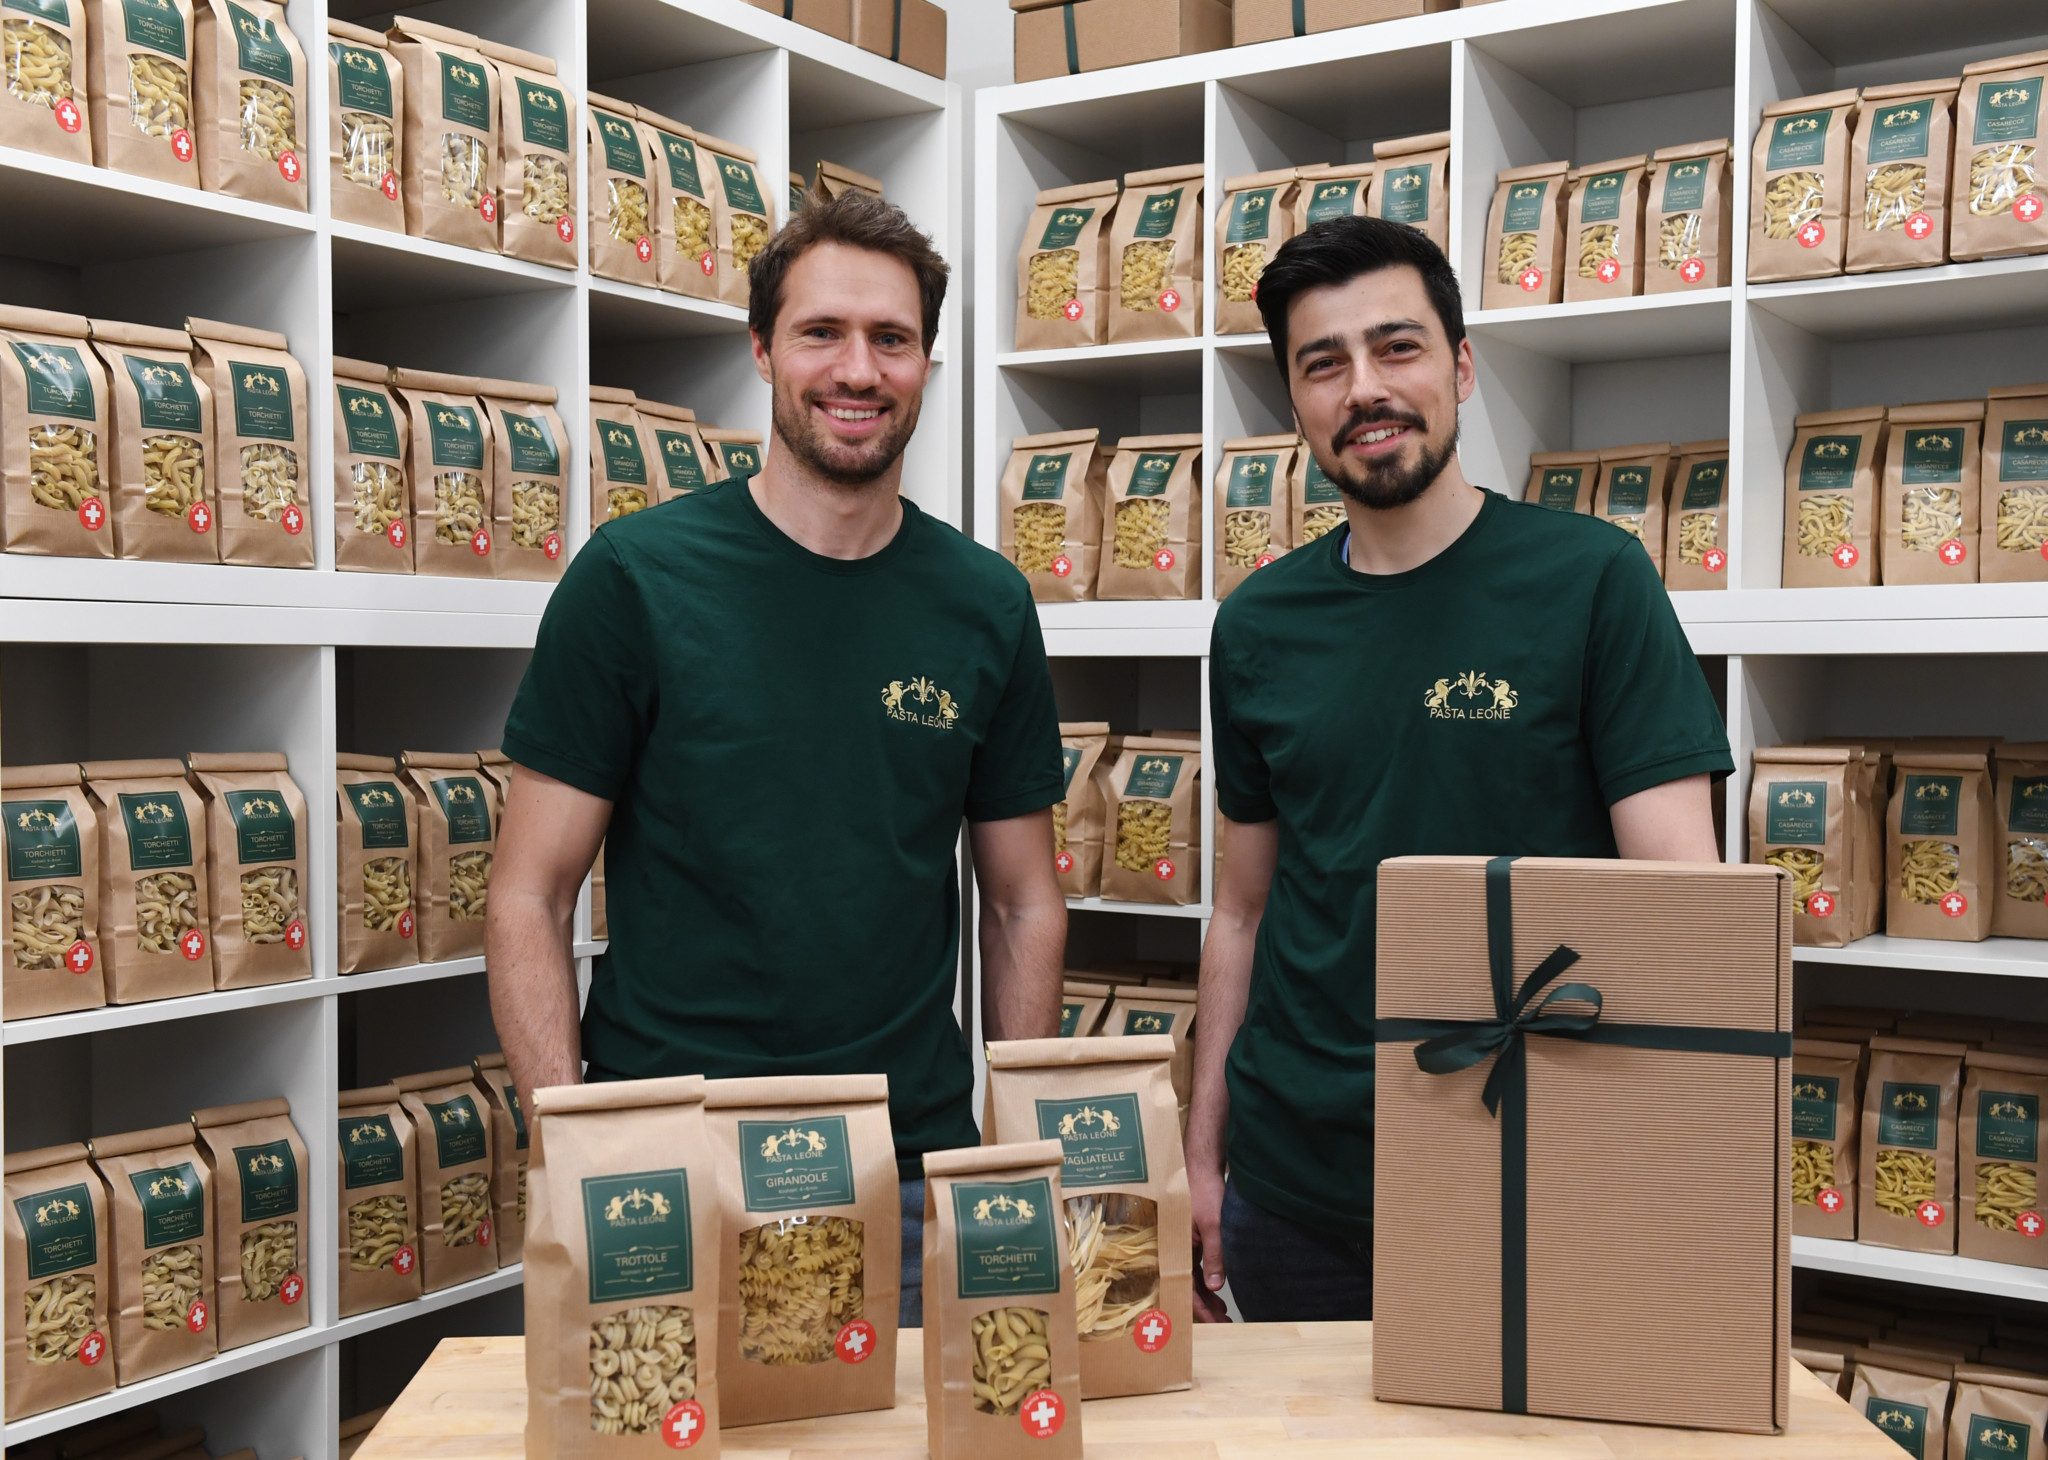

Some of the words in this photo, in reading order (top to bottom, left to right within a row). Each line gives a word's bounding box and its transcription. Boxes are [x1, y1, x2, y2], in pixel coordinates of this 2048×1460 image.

[138, 18, 174, 36] TORCHIETTI
[153, 401, 190, 411] TORCHIETTI
[248, 410, 282, 420] TORCHIETTI
[886, 708, 919, 724] PASTA
[921, 714, 954, 730] LEONE
[1430, 708, 1466, 719] PASTA
[1468, 708, 1511, 719] LEONE
[143, 840, 179, 848] TORCHIETTI
[251, 835, 285, 843] TORCHIETTI
[24, 850, 67, 858] TORCHIETTI
[1792, 1115, 1824, 1124] ASARECCE
[1063, 1132, 1088, 1143] PASTA
[1090, 1129, 1118, 1140] LEONE
[766, 1152, 792, 1164] PASTA
[794, 1149, 825, 1161] LEONE
[1063, 1151, 1126, 1166] TAGLIATELLE
[765, 1171, 829, 1189] GIRANDOLE
[158, 1212, 194, 1225] TORCHIETTI
[609, 1216, 637, 1228] PASTA
[638, 1213, 669, 1225] LEONE
[977, 1217, 1003, 1228] PASTA
[1004, 1214, 1033, 1225] LEONE
[44, 1239, 83, 1254] TORCHIETTI
[615, 1251, 669, 1268] TROTTOLE
[979, 1252, 1038, 1267] TORCHIETTI
